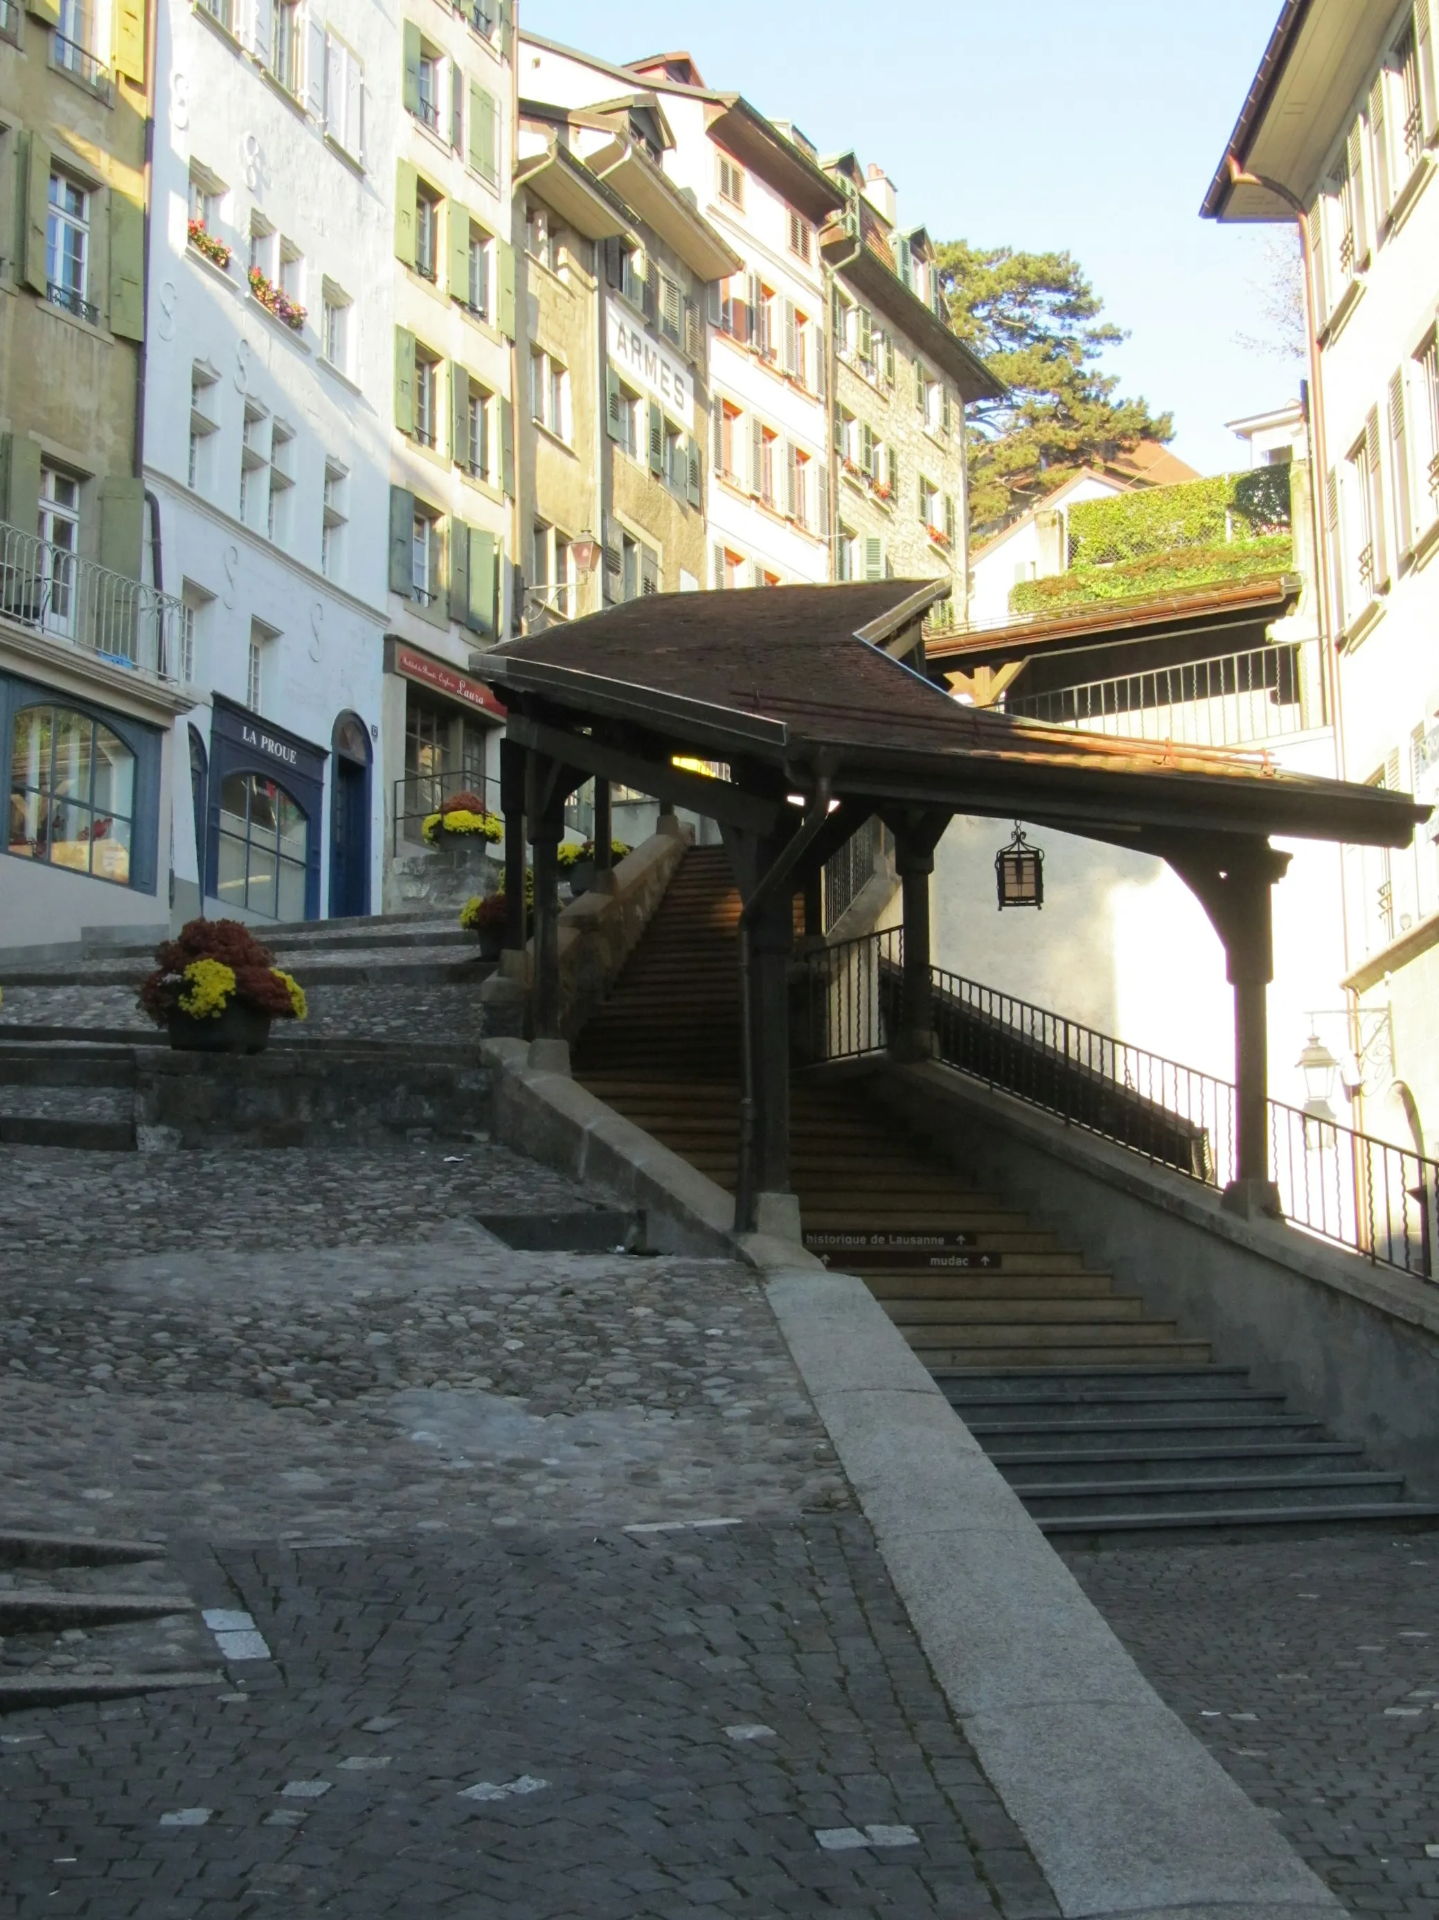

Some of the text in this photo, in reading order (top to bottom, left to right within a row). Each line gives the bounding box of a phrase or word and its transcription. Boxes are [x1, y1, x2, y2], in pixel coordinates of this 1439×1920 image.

[617, 321, 685, 411] ARMES
[456, 679, 485, 705] Laura
[242, 726, 297, 765] LA PROUE
[806, 1233, 945, 1245] historique de Lausanne
[930, 1255, 969, 1267] mudac
